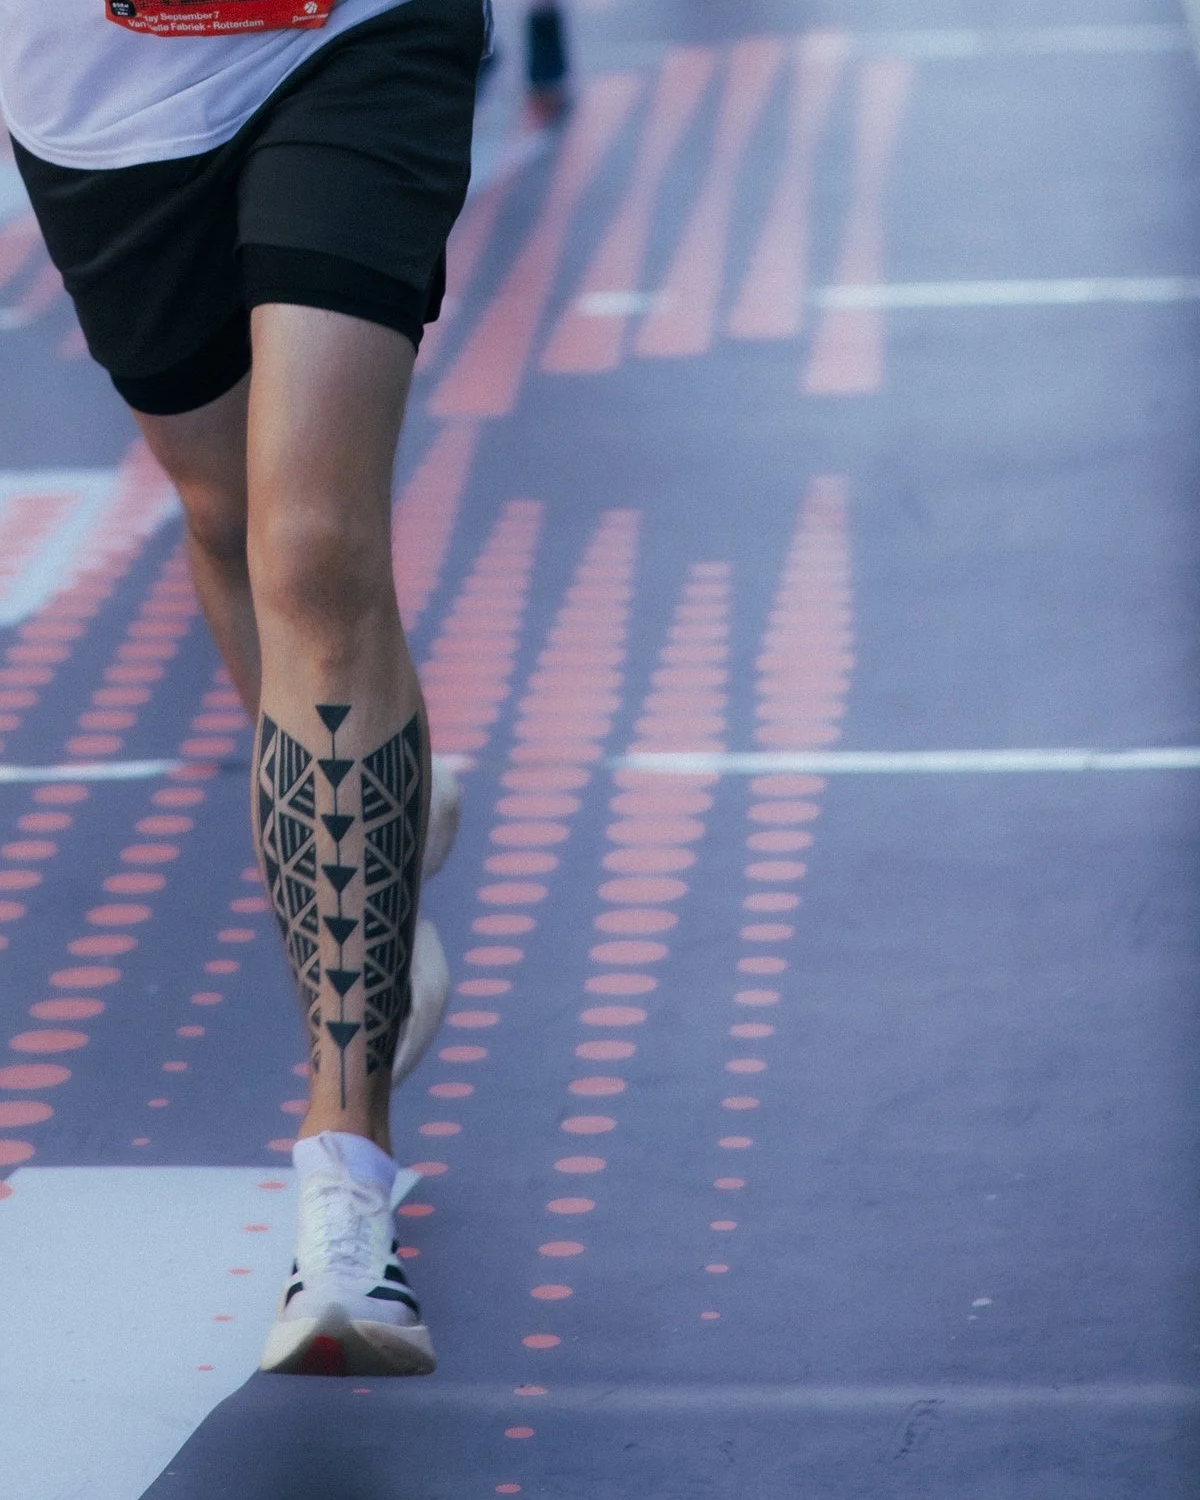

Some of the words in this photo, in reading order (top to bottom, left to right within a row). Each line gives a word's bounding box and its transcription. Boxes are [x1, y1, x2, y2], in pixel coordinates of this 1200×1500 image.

[159, 12, 212, 21] September
[213, 10, 220, 19] 7
[128, 19, 147, 28] Van
[171, 21, 206, 32] Fabriek
[212, 19, 265, 30] Rotterdam
